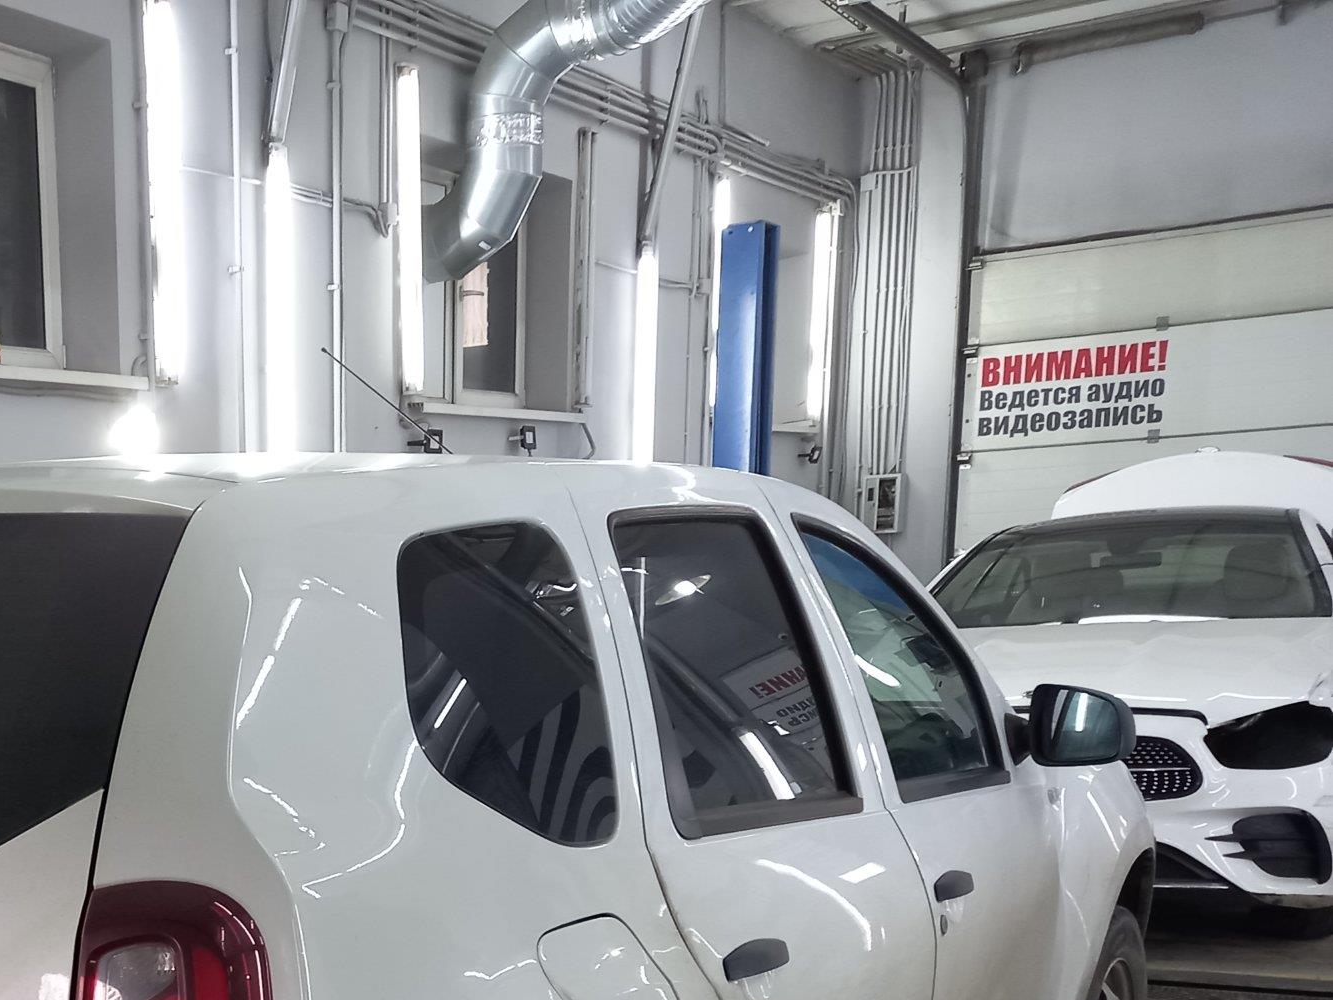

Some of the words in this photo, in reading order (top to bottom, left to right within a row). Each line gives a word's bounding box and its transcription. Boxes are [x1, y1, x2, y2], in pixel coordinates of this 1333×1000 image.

[981, 340, 1168, 387] ВНИМАНИЕ!
[979, 385, 1081, 412] Ведется
[1087, 378, 1165, 405] аудио
[977, 403, 1163, 438] видеозапись
